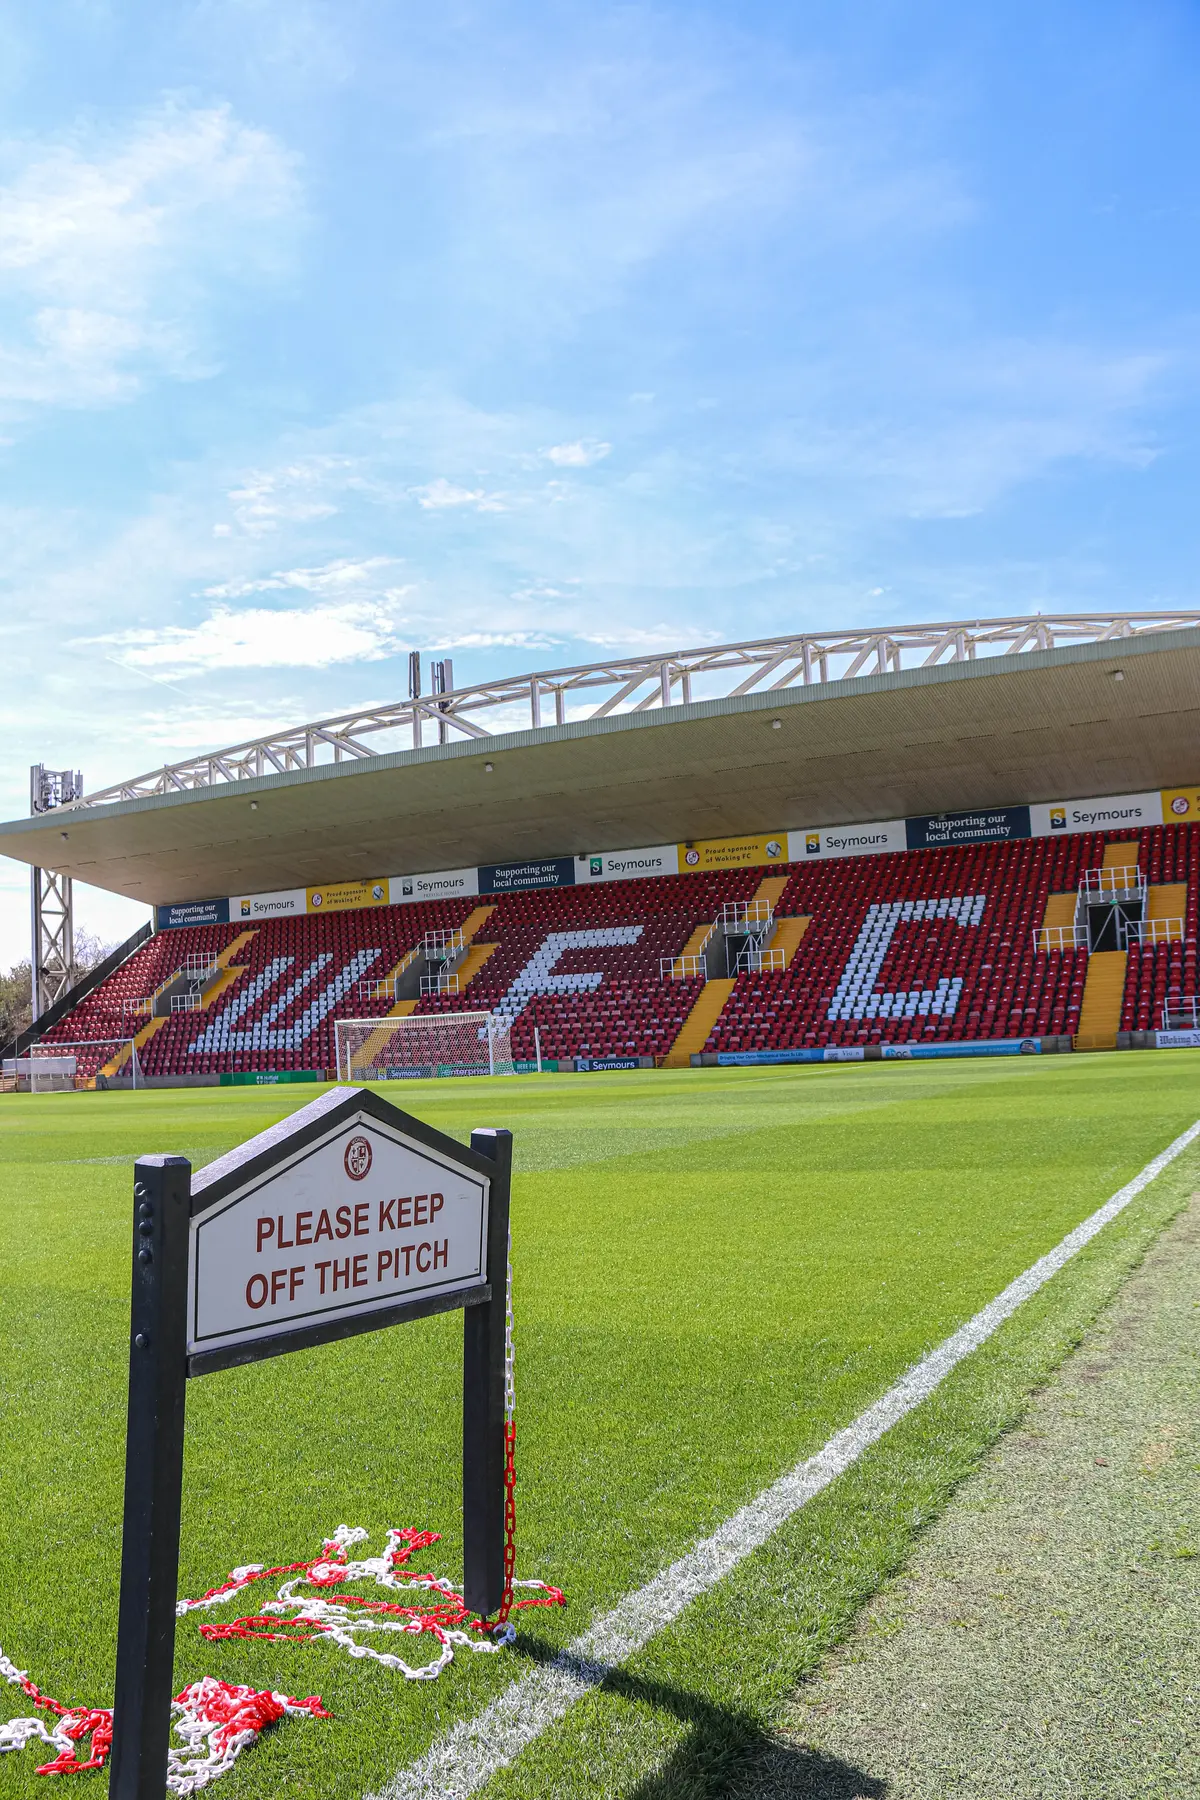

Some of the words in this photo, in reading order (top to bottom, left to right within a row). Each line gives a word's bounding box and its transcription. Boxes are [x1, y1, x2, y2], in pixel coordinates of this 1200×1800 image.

[928, 816, 986, 831] Supporting
[988, 814, 1006, 824] our
[1072, 808, 1142, 824] Seymours
[925, 830, 950, 841] local
[952, 825, 1011, 839] community
[727, 844, 759, 852] sponsors
[826, 834, 888, 849] Seymours
[495, 865, 540, 879] Supporting
[541, 864, 556, 872] our
[607, 858, 662, 872] Seymours
[417, 878, 464, 891] Seymours
[493, 877, 512, 887] local
[513, 874, 559, 885] community
[343, 888, 367, 896] sponsors
[171, 905, 204, 916] Supporting
[204, 904, 216, 912] our
[253, 900, 295, 913] Seymours
[169, 915, 184, 924] local
[184, 912, 218, 921] community
[592, 1061, 635, 1070] Seymours
[391, 1069, 420, 1078] Seymours
[256, 1202, 370, 1253] PLEASE
[378, 1192, 444, 1232] KEEP
[245, 1265, 306, 1310] OFF
[314, 1253, 368, 1295] THE
[377, 1238, 449, 1282] PITCH
